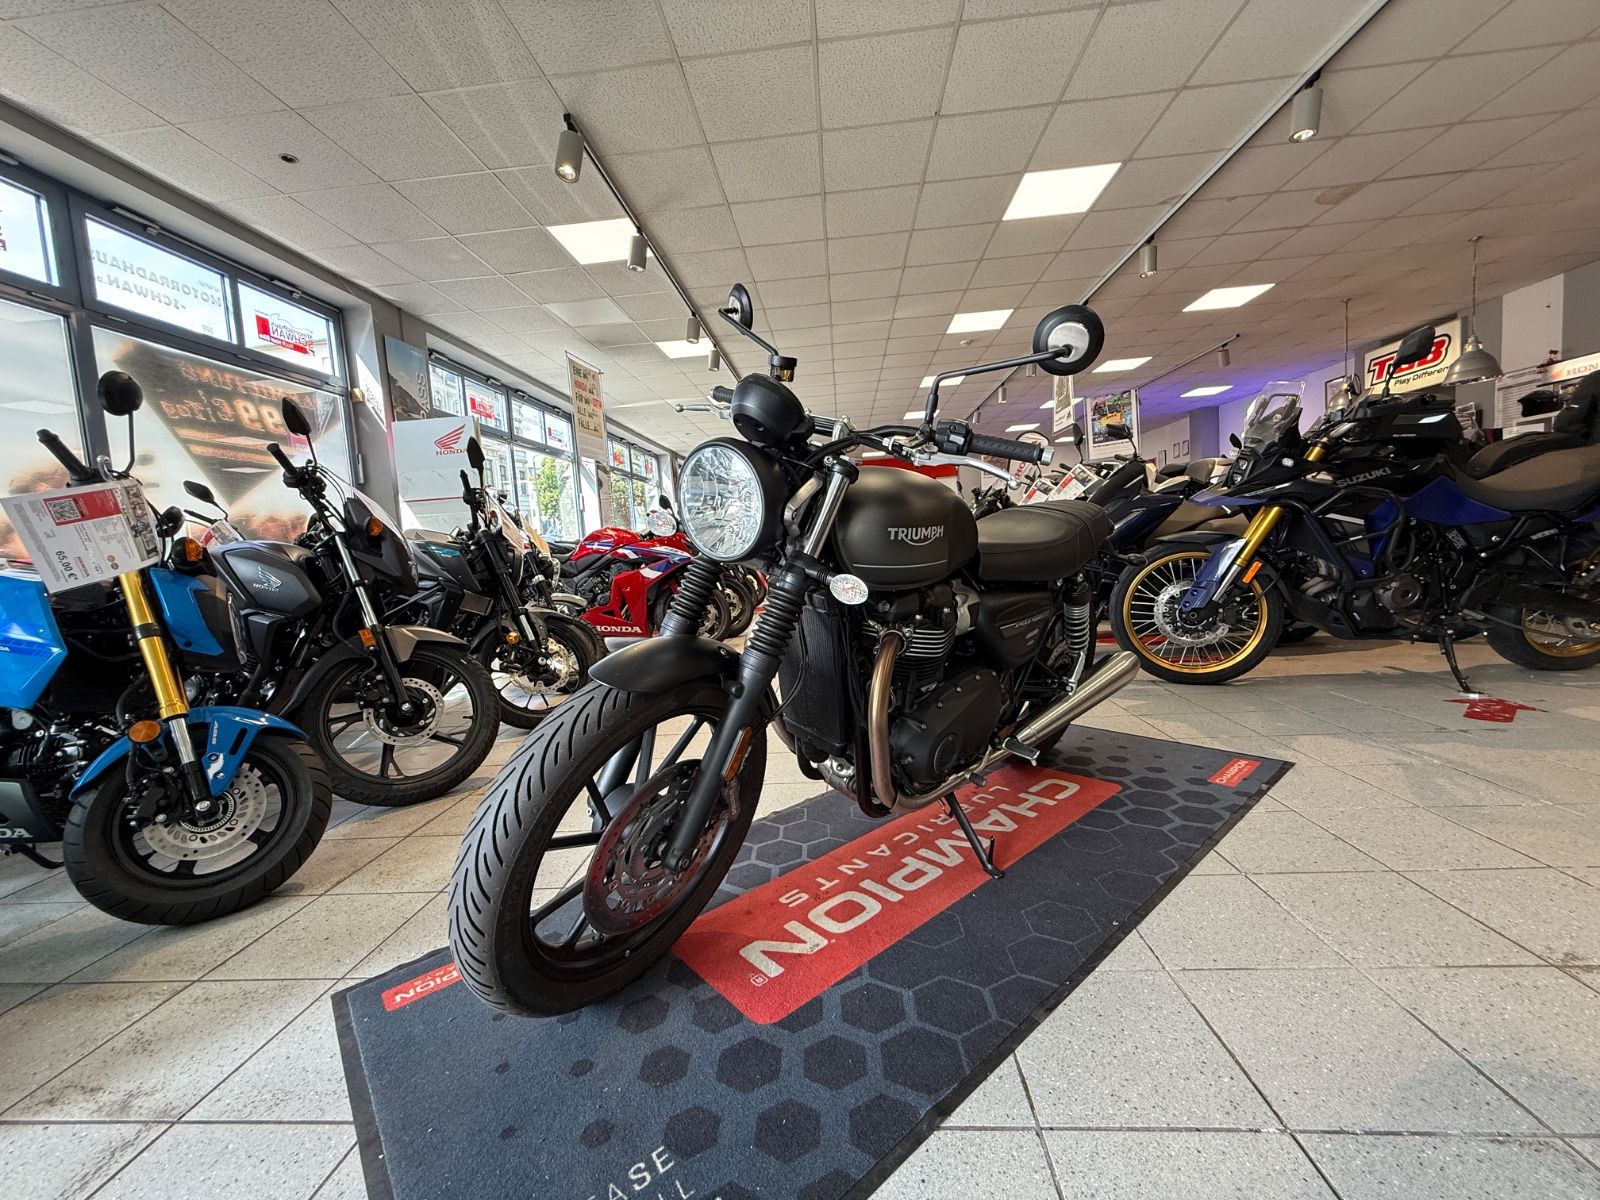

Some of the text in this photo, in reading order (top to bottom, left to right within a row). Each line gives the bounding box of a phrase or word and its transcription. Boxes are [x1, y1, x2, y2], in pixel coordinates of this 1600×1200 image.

[1368, 335, 1450, 386] TB
[1394, 366, 1449, 387] Play Differen
[1336, 466, 1391, 487] SUZUKI
[888, 525, 944, 545] TRIUMPH
[55, 550, 74, 572] 65,00
[1215, 759, 1249, 785] CHAMPION
[738, 778, 1081, 979] CHAMPION
[587, 1145, 675, 1200] ASE
